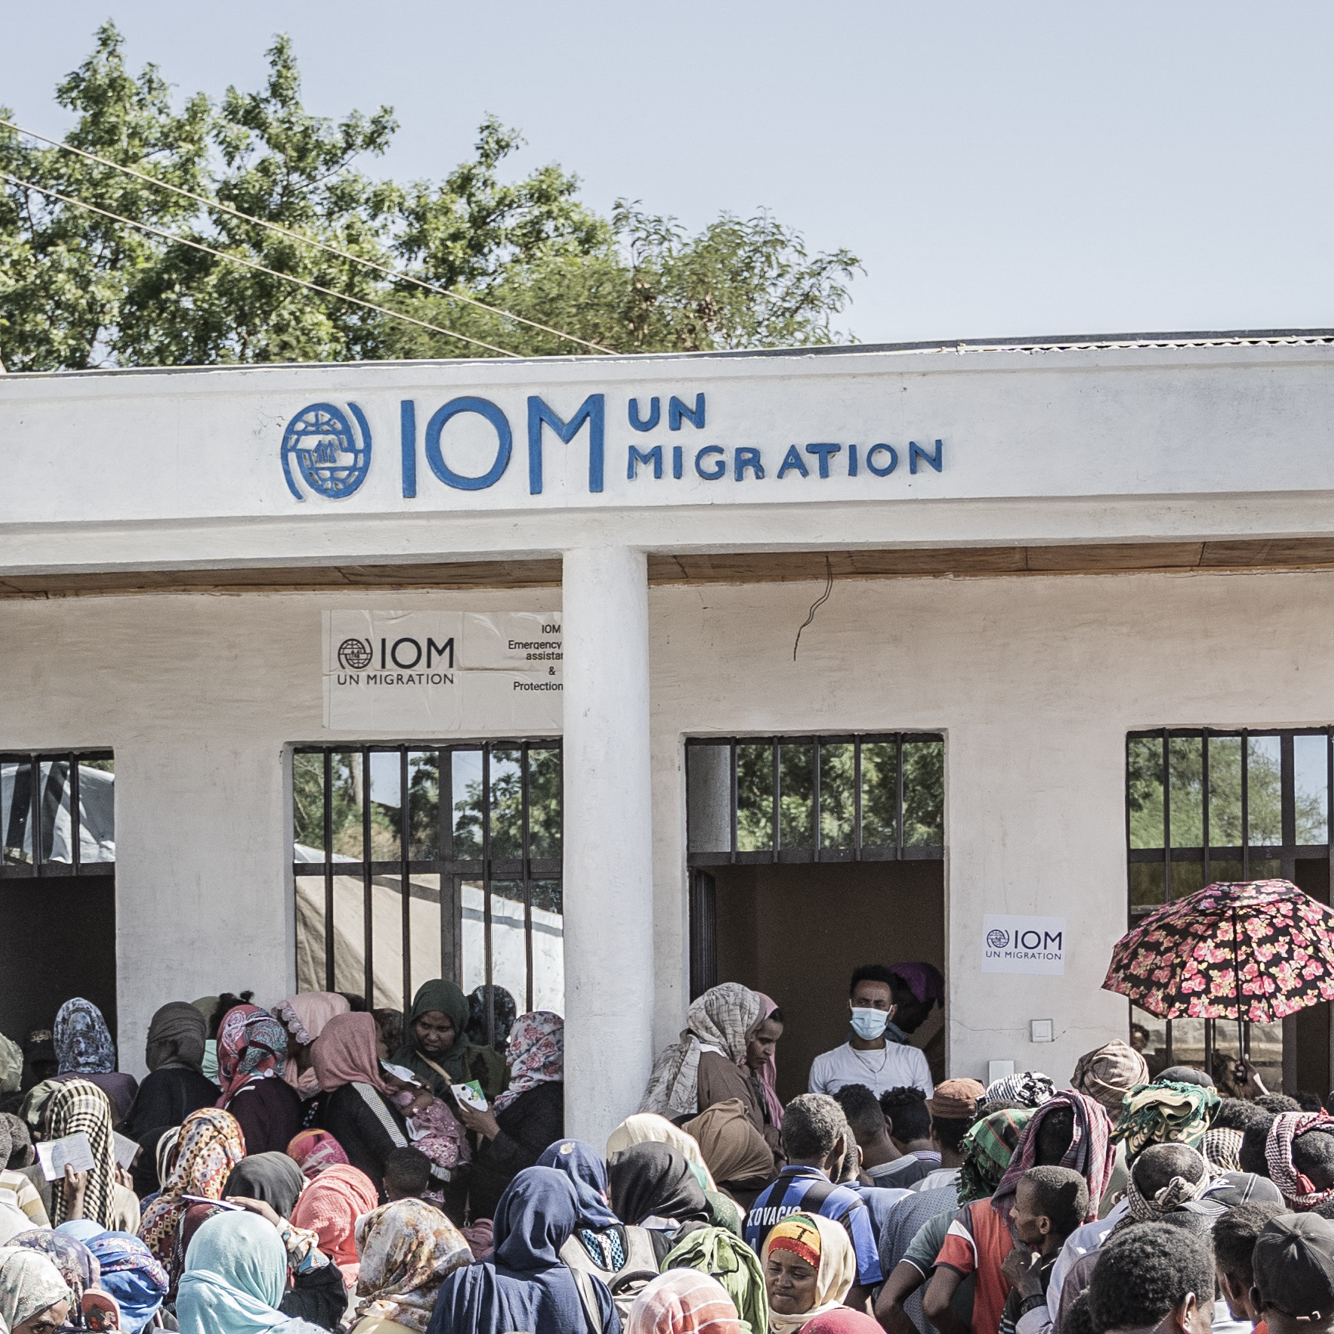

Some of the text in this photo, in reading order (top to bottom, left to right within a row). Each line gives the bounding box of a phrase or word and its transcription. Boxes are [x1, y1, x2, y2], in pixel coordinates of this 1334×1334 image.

[628, 392, 707, 431] UN
[400, 393, 605, 498] IOM
[626, 439, 944, 482] MIGRATION
[541, 624, 561, 634] IOM
[508, 640, 563, 650] Emergency
[380, 637, 455, 670] IOM
[548, 666, 556, 676] &
[337, 673, 455, 686] UN MIGRATION
[513, 681, 564, 691] Protection
[1014, 930, 1063, 951] IOM
[985, 950, 1062, 960] UN MIGRATION
